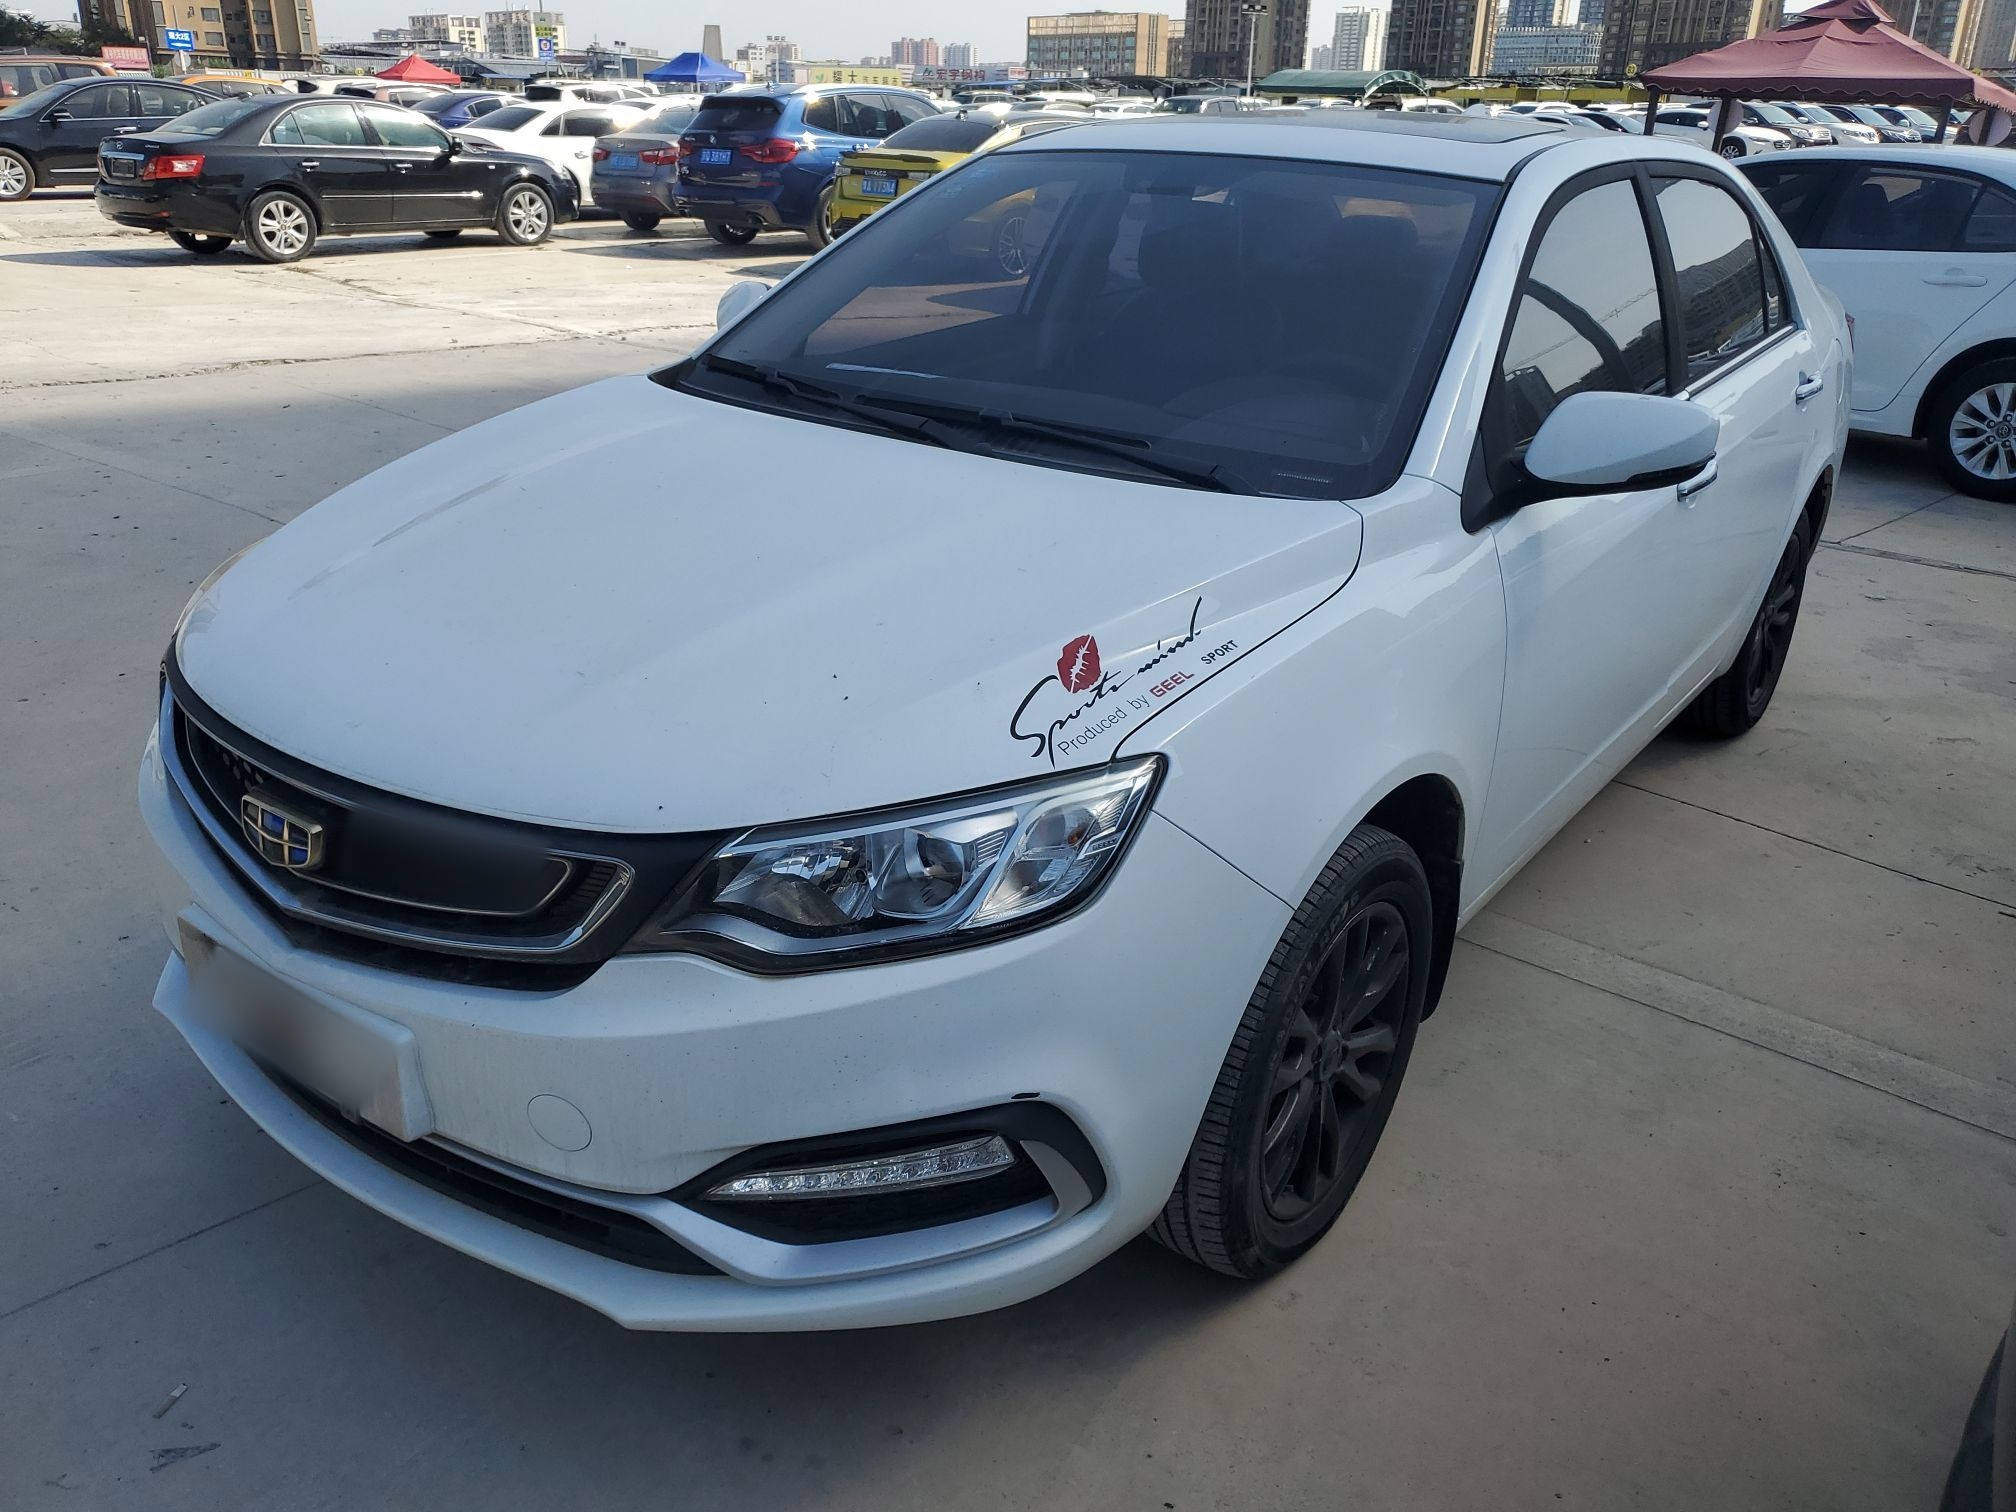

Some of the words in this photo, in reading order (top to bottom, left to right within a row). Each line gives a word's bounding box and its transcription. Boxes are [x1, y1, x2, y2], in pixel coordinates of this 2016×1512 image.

[1057, 709, 1128, 755] Produced
[1126, 694, 1150, 711] by
[1149, 671, 1195, 698] GEEL
[1201, 640, 1239, 664] SPORT
